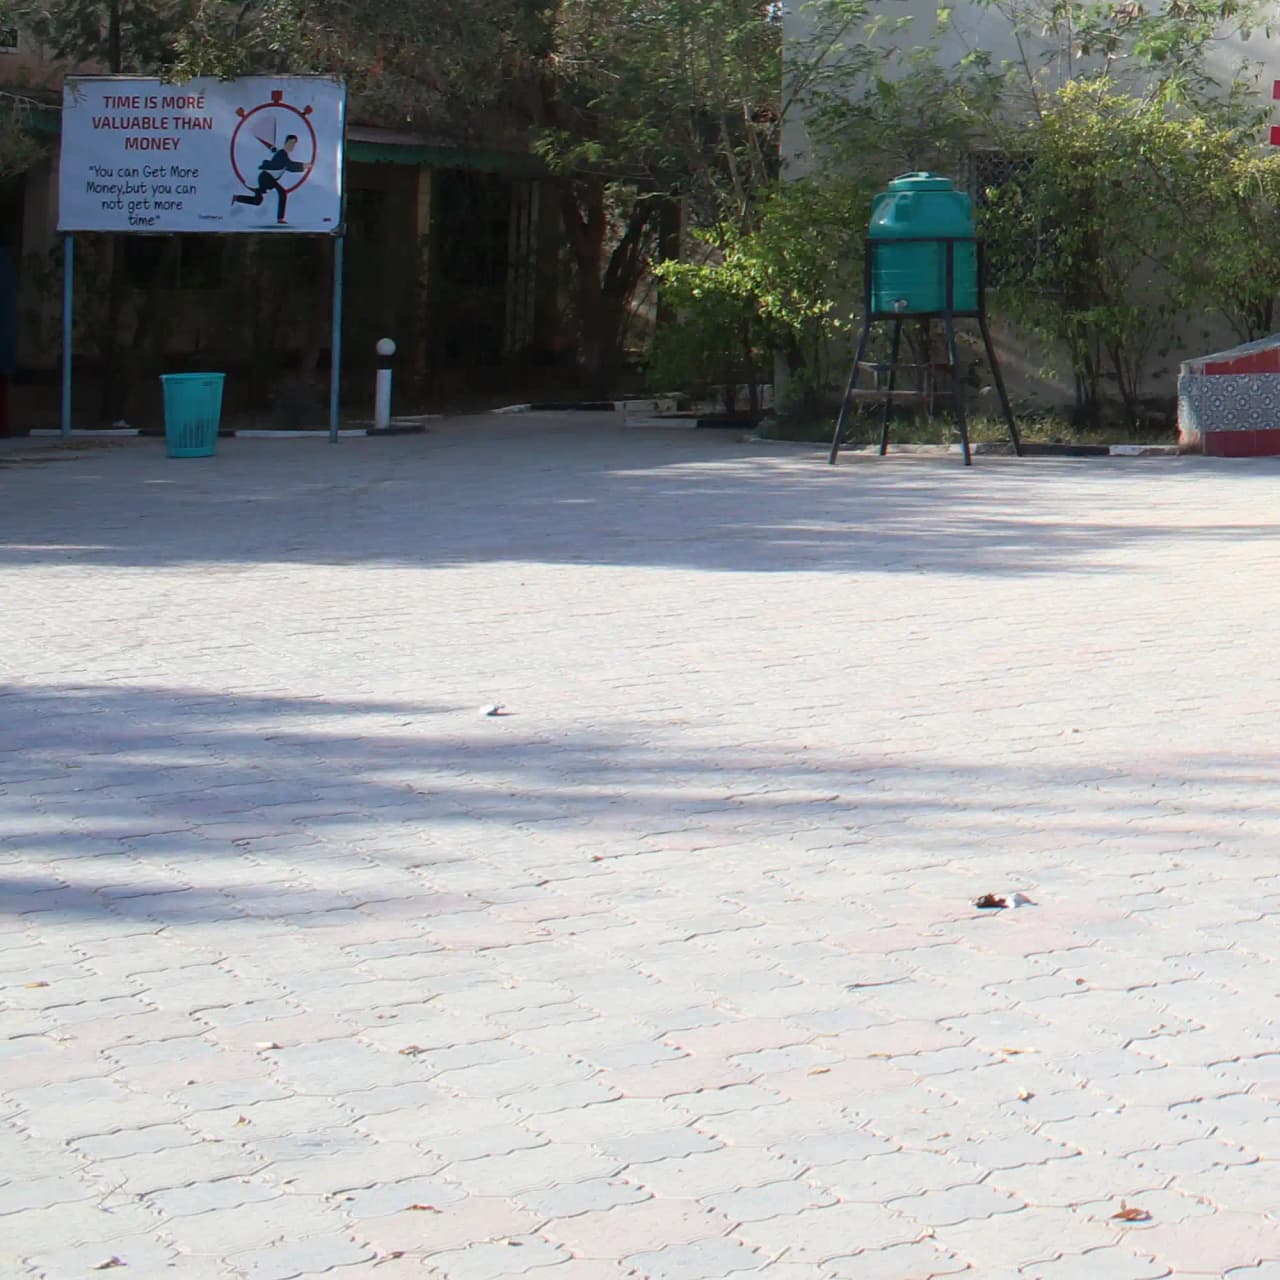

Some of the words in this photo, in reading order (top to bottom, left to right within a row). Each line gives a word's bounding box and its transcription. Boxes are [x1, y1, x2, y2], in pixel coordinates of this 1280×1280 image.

[103, 96, 140, 109] TIME
[144, 96, 158, 109] IS
[161, 96, 205, 109] MORE
[92, 116, 169, 130] VALUABLE
[173, 116, 213, 130] THAN
[124, 137, 181, 151] MONEY
[117, 168, 139, 178] can
[143, 165, 167, 178] Get
[170, 165, 199, 178] More
[151, 184, 172, 198] you
[175, 185, 197, 194] can
[101, 199, 124, 210] not
[127, 199, 151, 214] get
[154, 201, 184, 210] more
